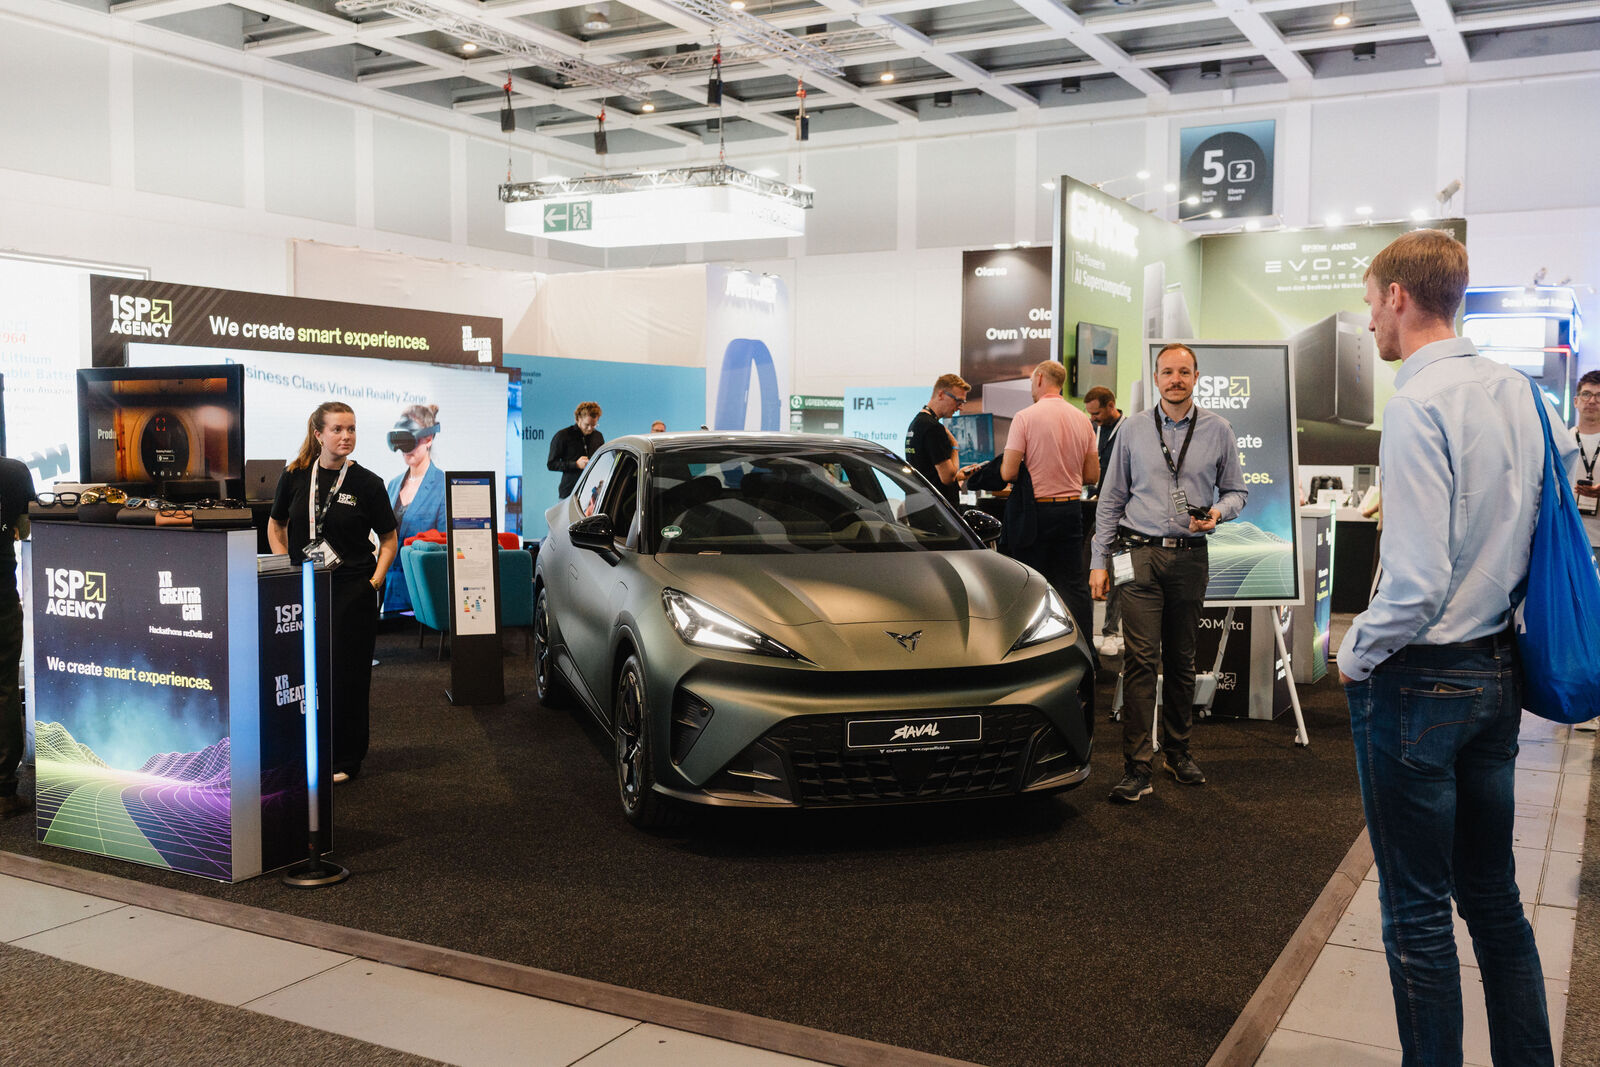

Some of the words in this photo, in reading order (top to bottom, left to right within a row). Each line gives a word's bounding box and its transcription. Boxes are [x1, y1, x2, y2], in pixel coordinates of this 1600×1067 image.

[1202, 149, 1225, 185] 5
[1235, 163, 1247, 179] 2
[110, 294, 151, 321] 1SP
[110, 319, 172, 338] AGENCY
[209, 315, 239, 337] We
[242, 322, 295, 341] create
[298, 327, 342, 345] smart
[344, 331, 430, 350] experiences.
[986, 327, 1018, 340] Own
[0, 332, 27, 345] 964
[2, 351, 52, 366] Lithium
[5, 368, 31, 379] able
[292, 375, 325, 393] Class
[327, 382, 364, 398] Virtual
[366, 388, 400, 402] Reality
[402, 392, 427, 404] Zone
[853, 397, 874, 410] IFA
[1193, 397, 1250, 409] AGENCY
[853, 430, 869, 440] The
[871, 430, 898, 440] future
[1237, 434, 1262, 448] ate
[45, 568, 85, 599] 1SP
[45, 599, 106, 620] AGENCY
[275, 603, 303, 623] 1SP
[275, 620, 305, 634] AGEN
[1213, 619, 1244, 630] Mta
[46, 656, 66, 672] We
[67, 661, 103, 677] create
[103, 667, 137, 681] smart
[138, 671, 213, 691] experiences.
[275, 674, 289, 691] XR
[276, 682, 318, 706] CREAT
